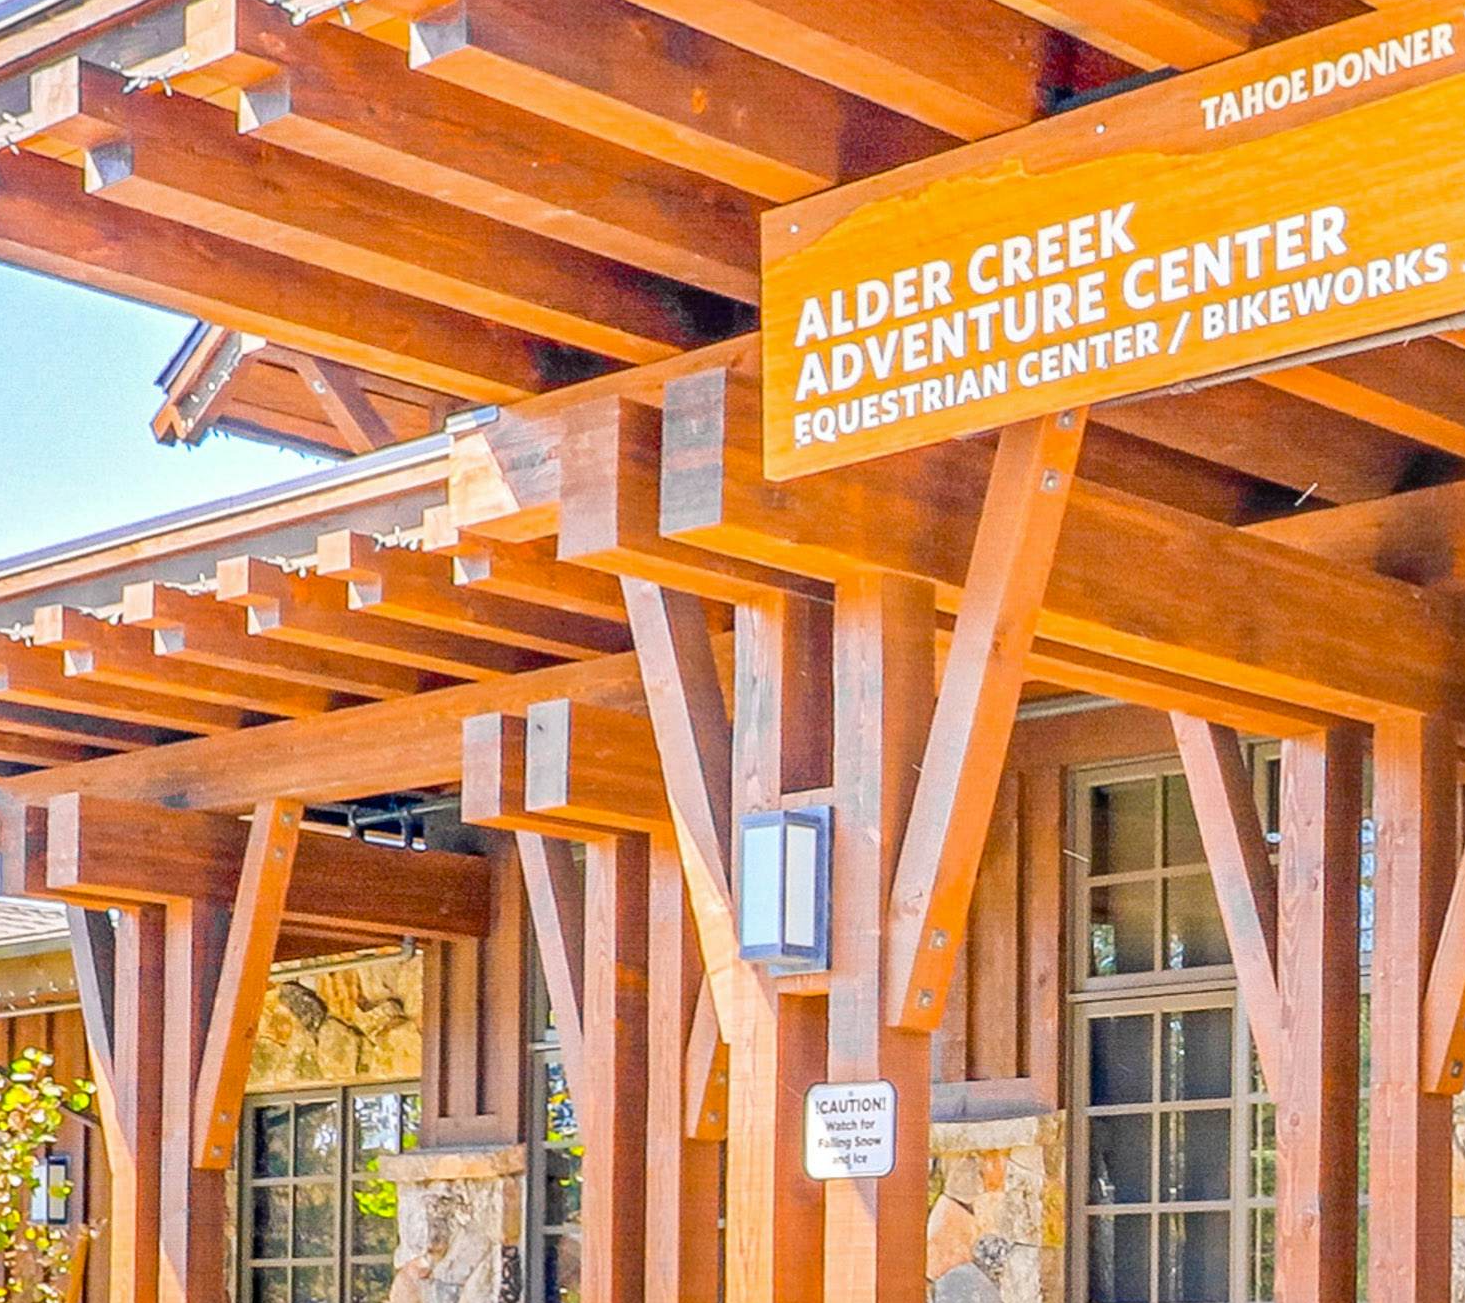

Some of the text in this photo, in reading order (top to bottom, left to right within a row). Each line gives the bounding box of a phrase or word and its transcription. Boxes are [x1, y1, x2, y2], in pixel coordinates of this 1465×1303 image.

[1200, 22, 1455, 130] TAHOE DONNER
[794, 201, 1136, 348] ALDER CREEK
[794, 205, 1348, 402] ADVENTURE CENTER
[794, 242, 1450, 447] EQUESTRIAN CENTER / BIKEWORKS
[818, 1137, 881, 1150] Falling Snow
[826, 1119, 875, 1131] Watch for
[833, 1154, 850, 1164] and
